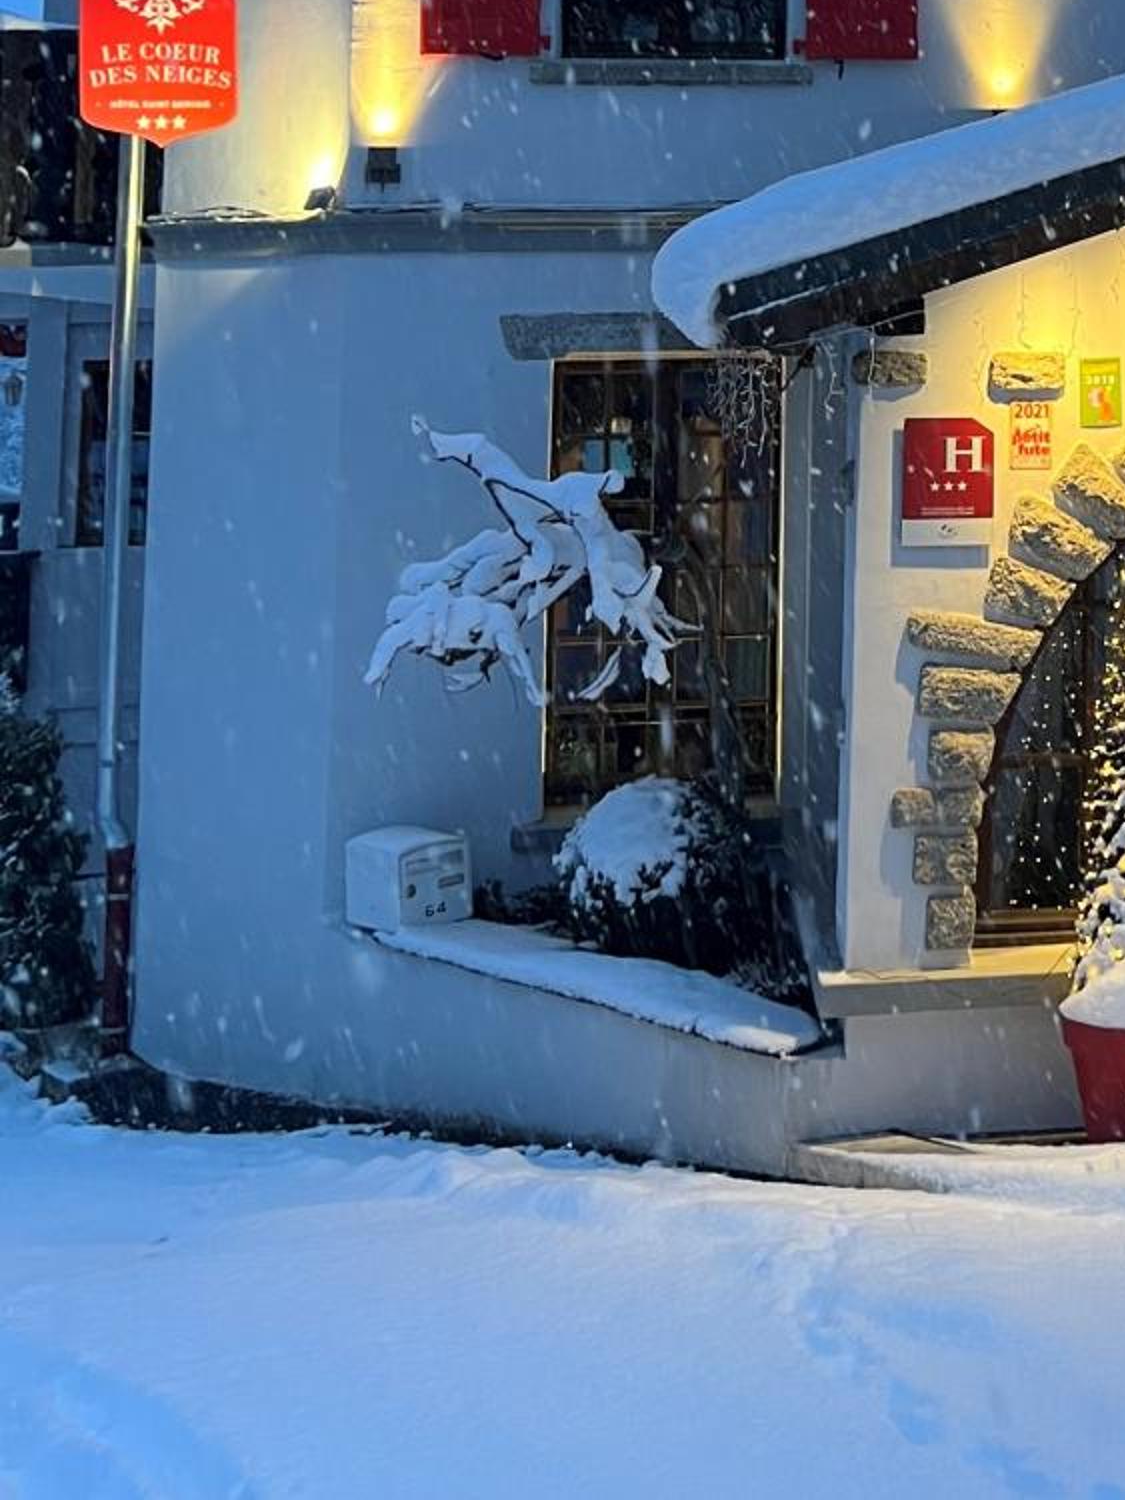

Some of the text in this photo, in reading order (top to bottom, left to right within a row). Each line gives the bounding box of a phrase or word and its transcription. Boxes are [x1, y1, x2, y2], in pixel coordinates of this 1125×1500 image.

[101, 41, 222, 65] LE COEUR
[89, 64, 233, 90] DES NEIGES
[1014, 403, 1049, 419] 2021
[944, 435, 987, 473] H
[425, 901, 447, 917] 64
